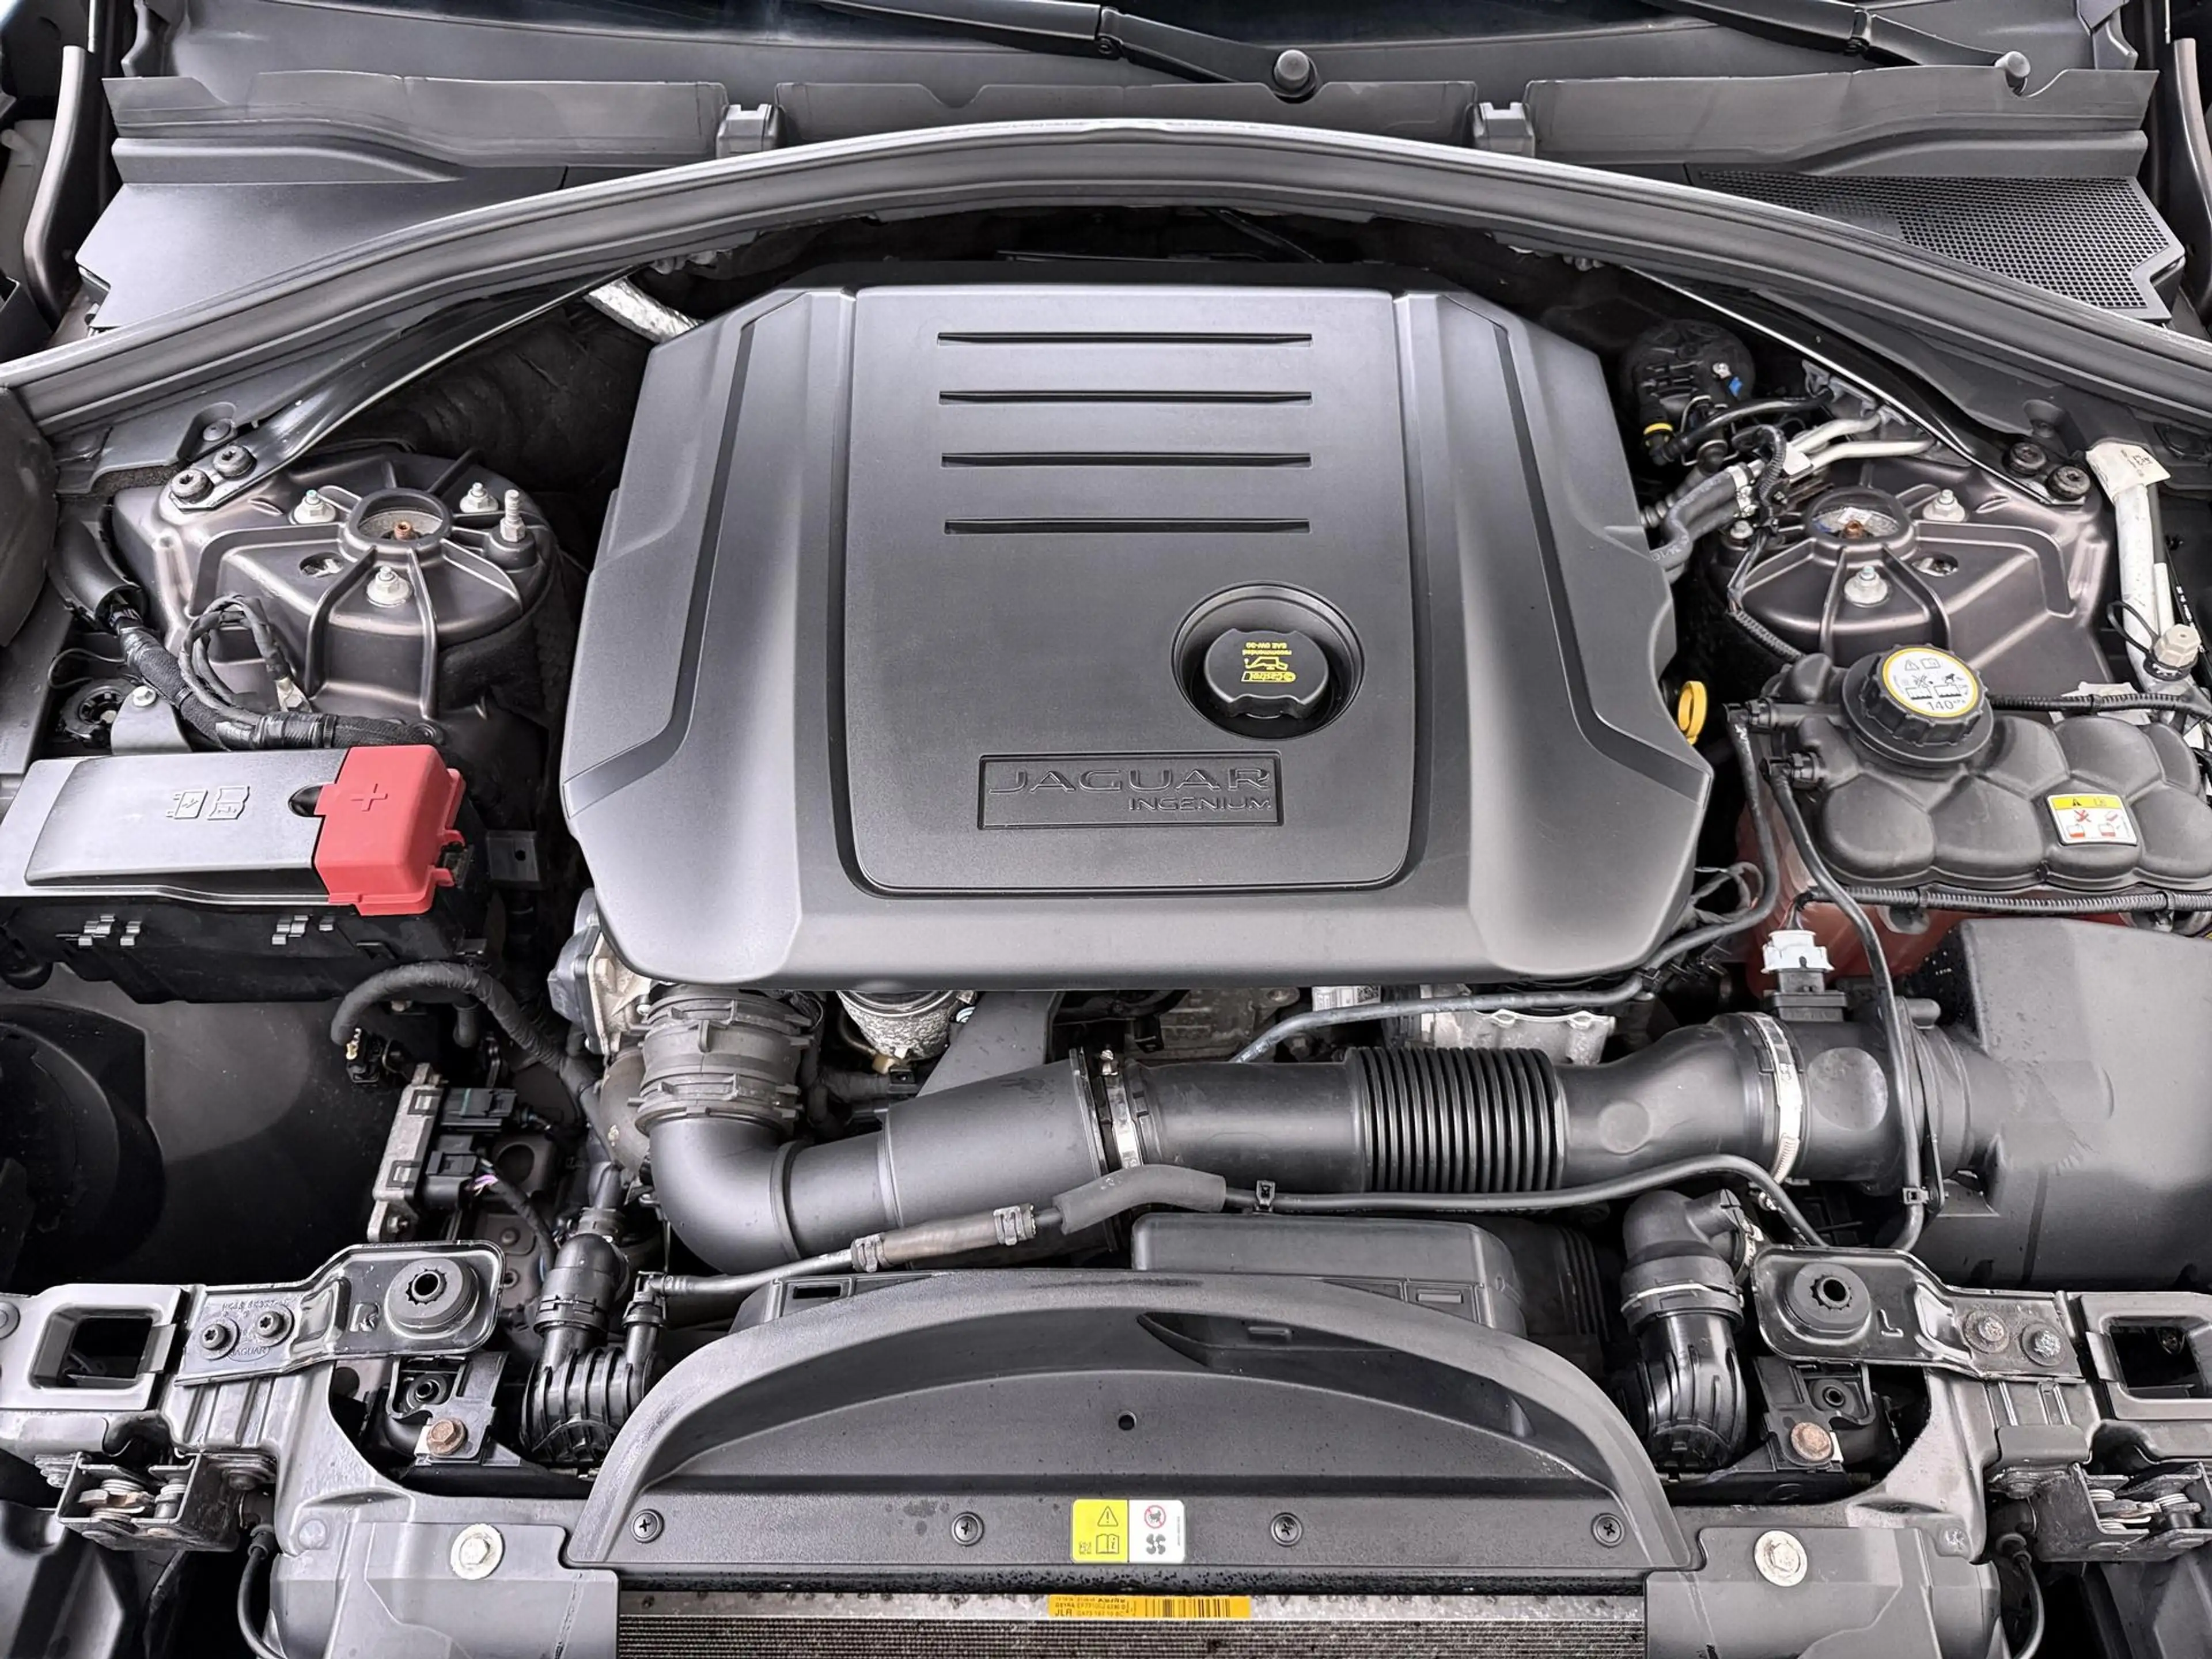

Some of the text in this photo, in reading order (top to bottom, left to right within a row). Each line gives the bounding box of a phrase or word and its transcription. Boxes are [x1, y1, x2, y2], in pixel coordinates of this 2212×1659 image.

[1248, 672, 1283, 681] Castrol
[1926, 700, 1954, 710] 140
[988, 768, 1271, 794] JAGUAR
[1127, 797, 1272, 812] INGENIUM
